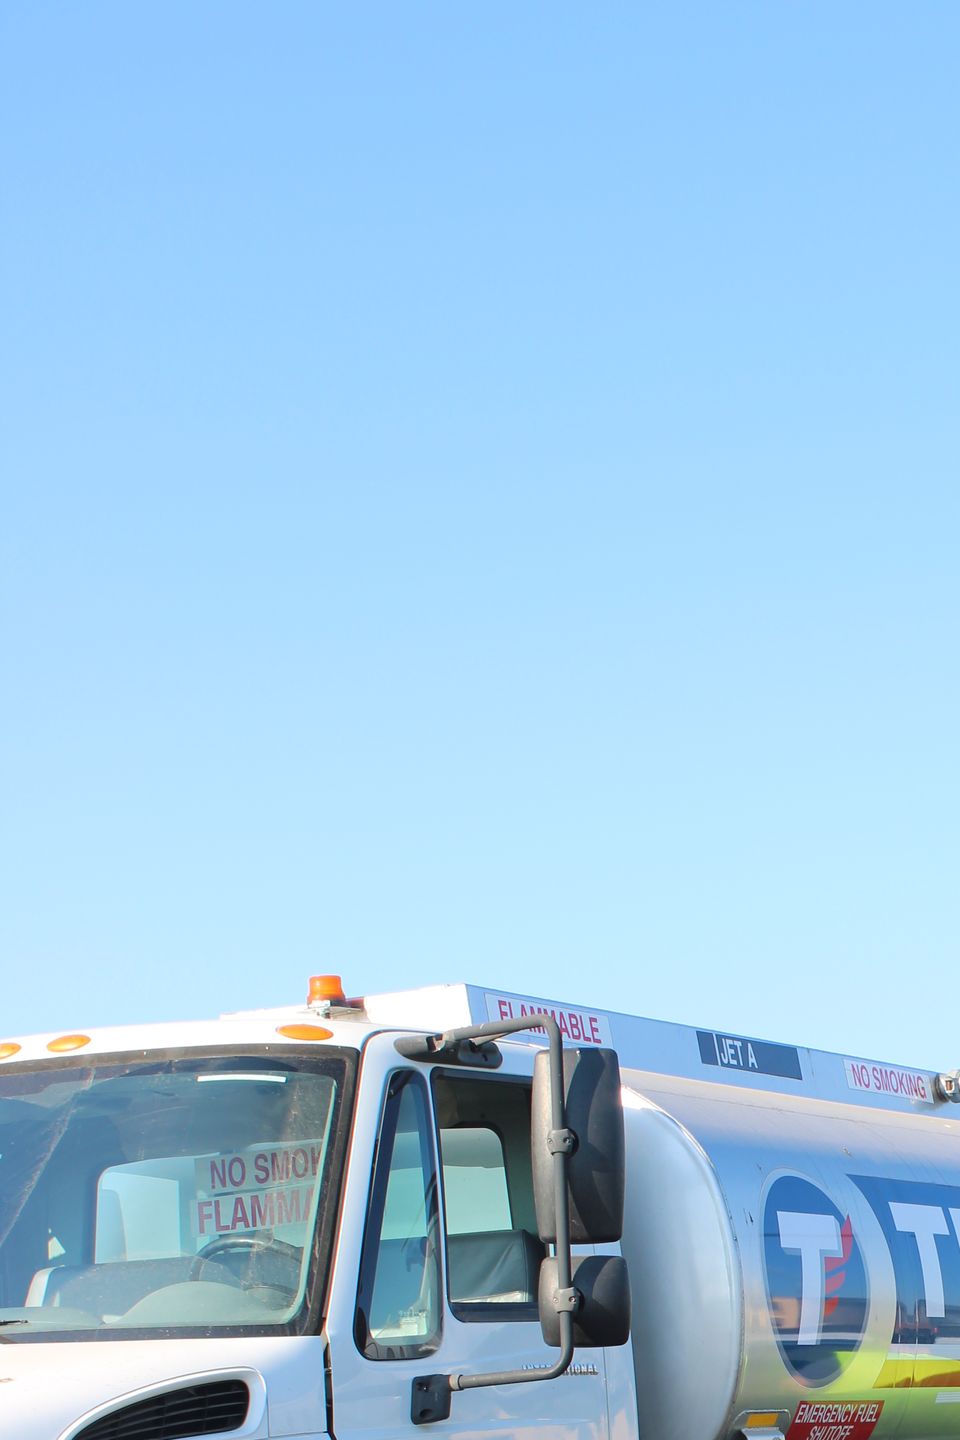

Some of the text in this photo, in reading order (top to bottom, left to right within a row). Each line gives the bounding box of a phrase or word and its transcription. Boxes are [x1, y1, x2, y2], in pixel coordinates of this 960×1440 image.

[721, 1038, 758, 1069] JET A
[850, 1063, 928, 1100] NO SMOKING
[210, 1157, 246, 1189] NO
[795, 1403, 879, 1423] EMERGENCY FUEL
